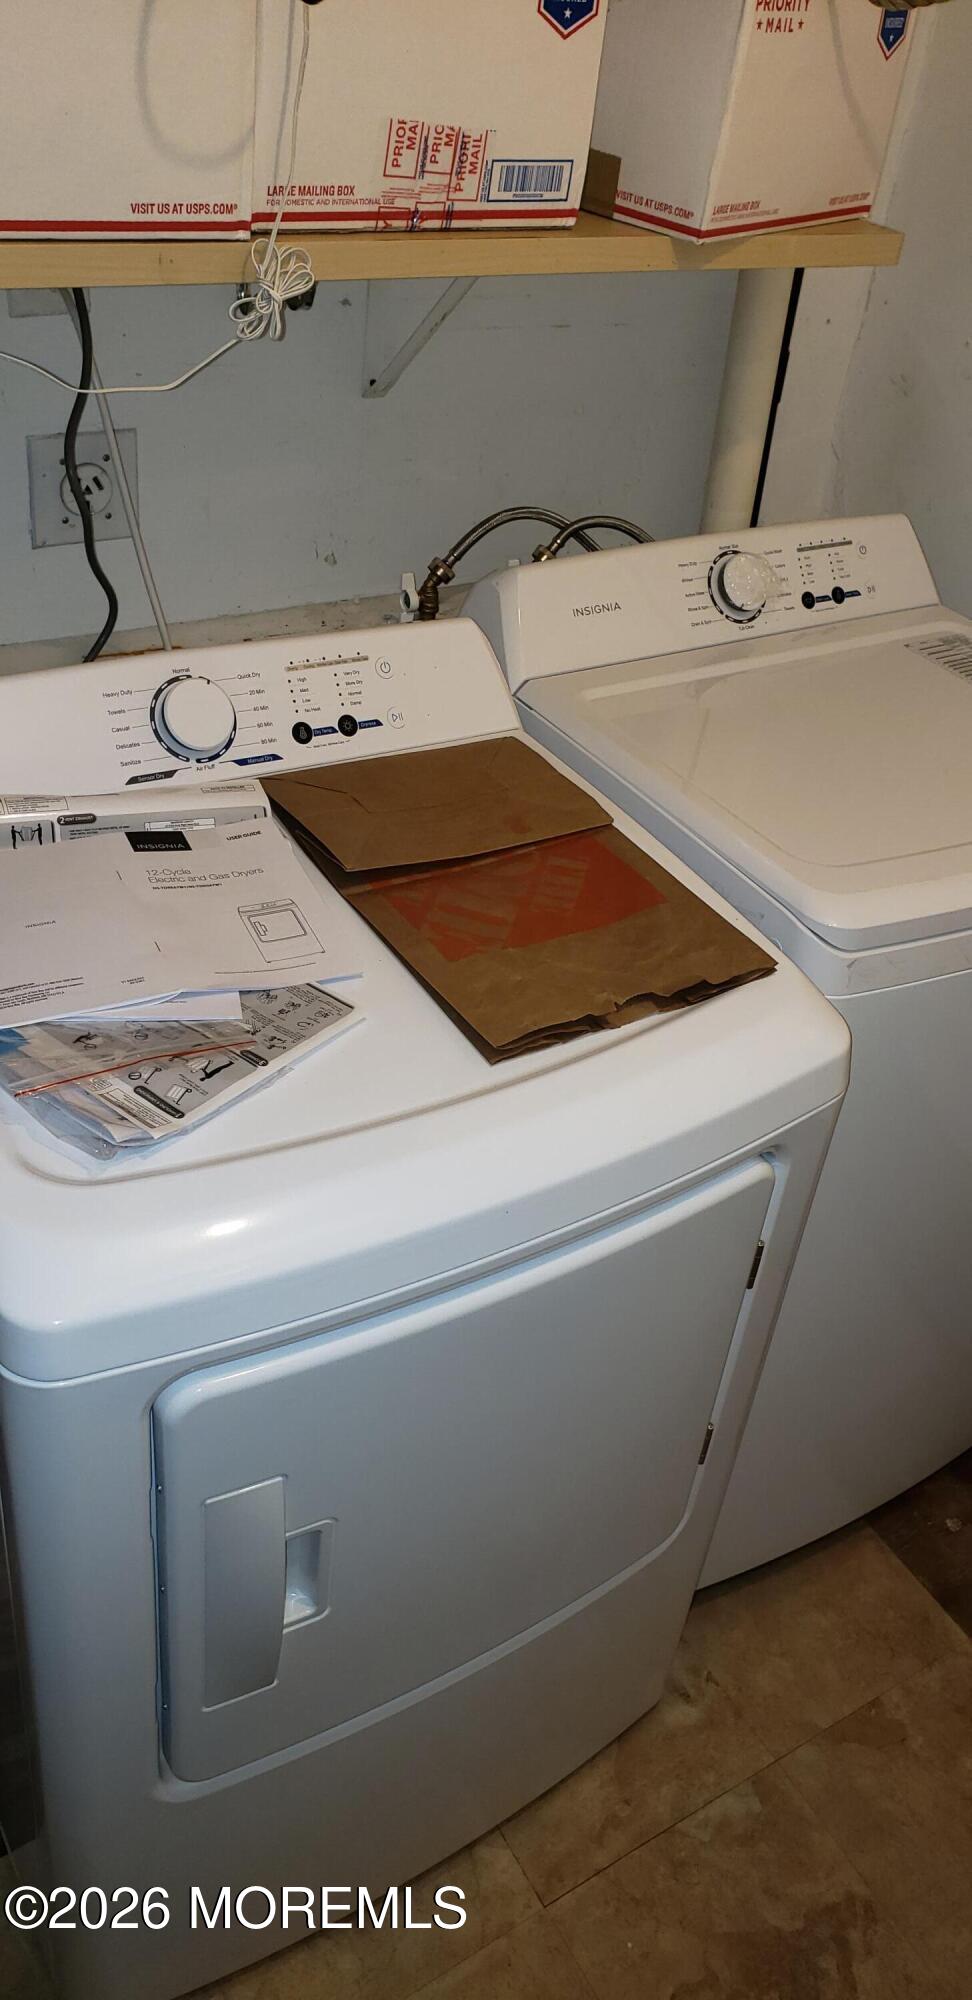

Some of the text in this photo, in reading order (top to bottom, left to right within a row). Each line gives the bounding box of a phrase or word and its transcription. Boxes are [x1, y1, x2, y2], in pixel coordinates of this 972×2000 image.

[756, 0, 810, 12] PRIORITY
[765, 16, 794, 33] MAIL
[468, 133, 483, 175] MAIL
[298, 184, 335, 196] MAILING
[337, 184, 356, 196] BOX
[316, 198, 331, 206] AND
[331, 198, 381, 206] INTERNATIONAL
[634, 194, 644, 206] US
[644, 198, 654, 209] AT
[130, 203, 155, 215] VISIT
[157, 203, 170, 214] US
[171, 203, 184, 214] AT
[572, 601, 622, 617] INSIGNIA
[102, 691, 119, 699] Heavy
[107, 708, 126, 716] Towels
[111, 725, 130, 733] Casual
[115, 741, 141, 750] Delicates
[120, 759, 142, 767] Sanitize
[138, 774, 155, 782] Sensor
[243, 830, 262, 838] GUIDE
[146, 867, 192, 877] 12-Cycle
[148, 867, 264, 884] Electric and Gas Dryers
